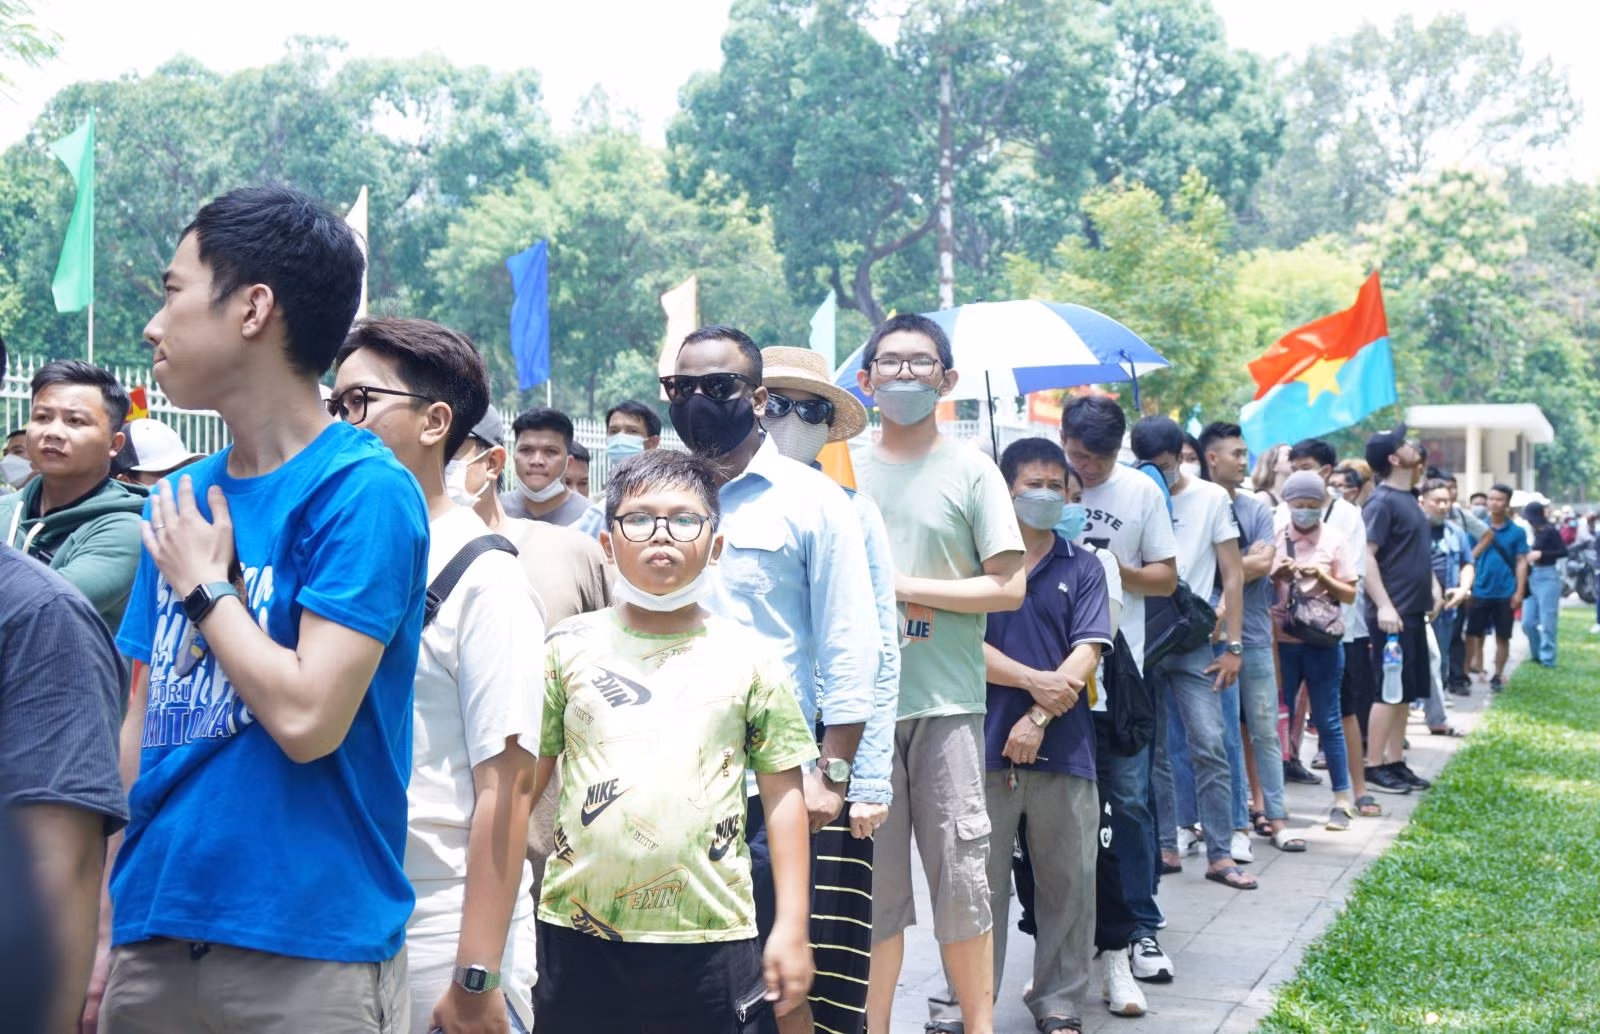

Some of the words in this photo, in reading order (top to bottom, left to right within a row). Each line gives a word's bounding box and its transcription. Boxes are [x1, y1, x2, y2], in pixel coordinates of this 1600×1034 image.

[1084, 508, 1123, 531] OSTE
[906, 619, 930, 638] LIE
[591, 674, 633, 708] NIKE
[586, 778, 620, 807] NIKE
[556, 826, 574, 859] NIE
[632, 886, 680, 909] NIKE
